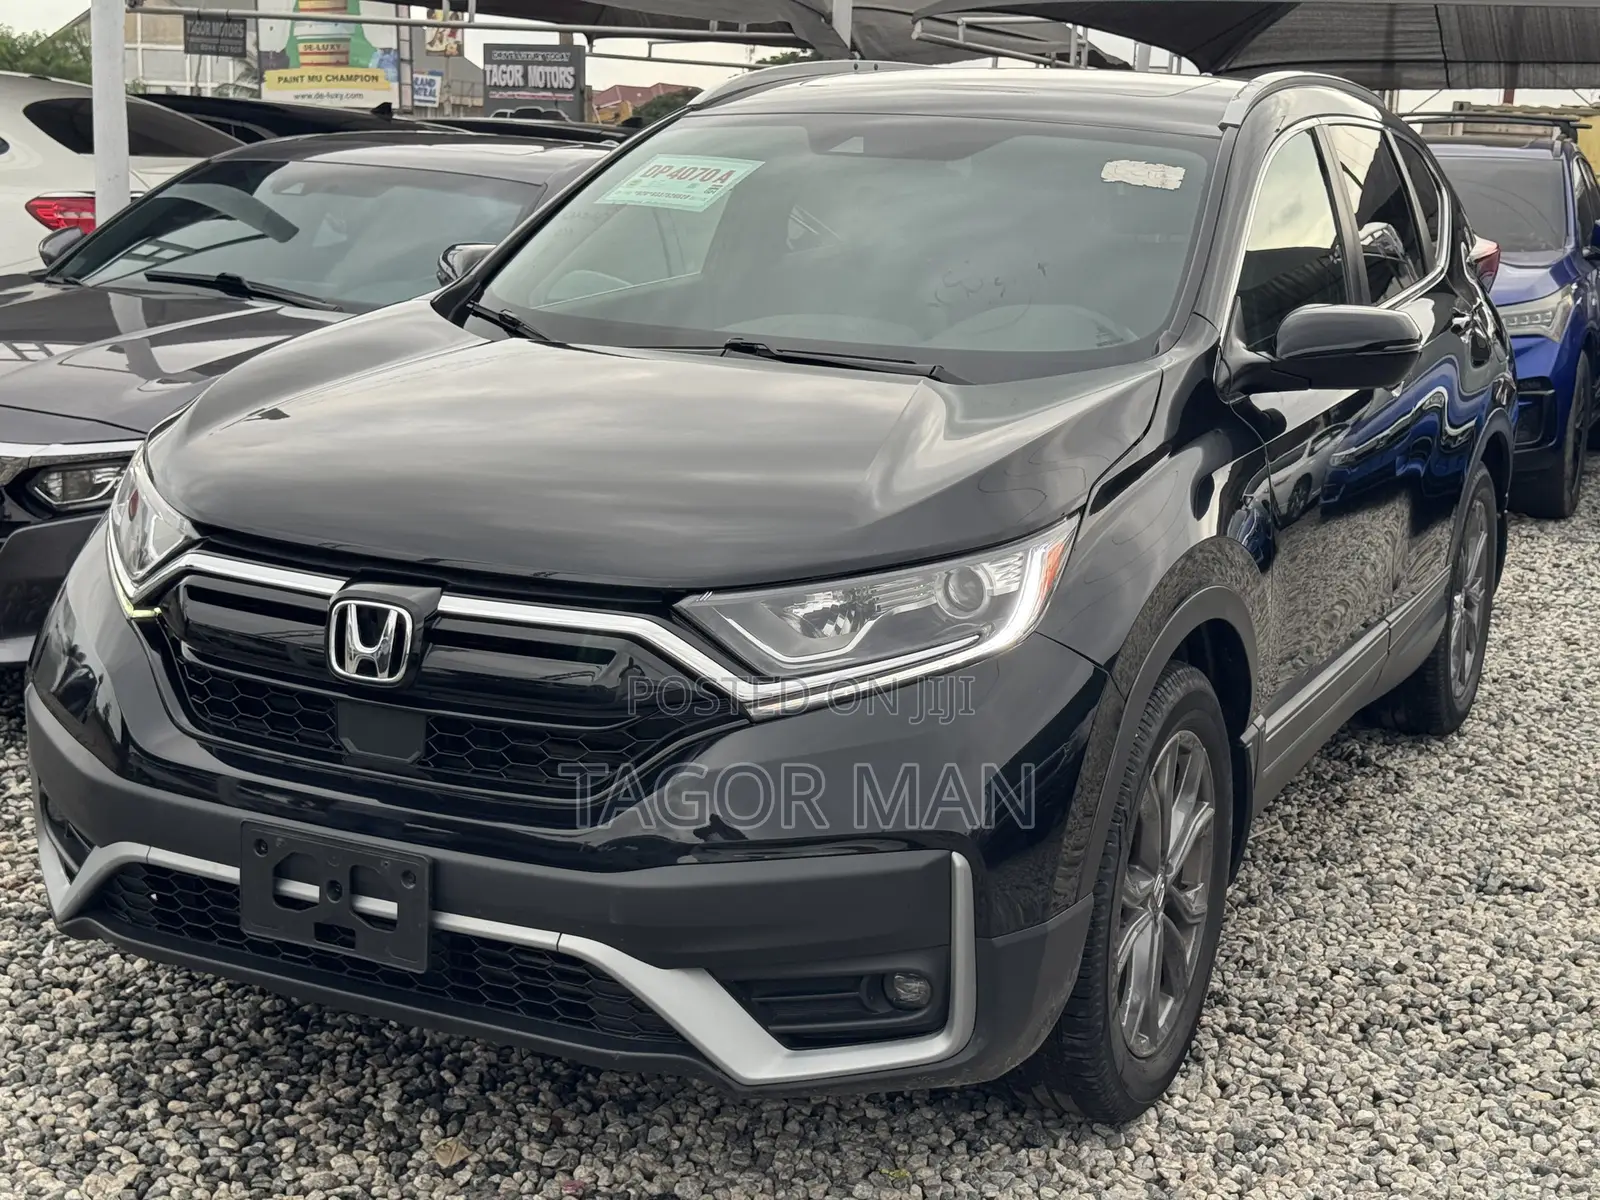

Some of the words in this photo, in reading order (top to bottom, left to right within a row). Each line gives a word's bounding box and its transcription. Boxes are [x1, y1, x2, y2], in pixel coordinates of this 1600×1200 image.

[303, 43, 341, 51] DE-LUXY
[277, 75, 305, 84] PAINT
[307, 74, 323, 83] MU
[325, 74, 379, 83] CHAMPION
[484, 64, 525, 86] TAGOR
[527, 65, 575, 89] MOTORS
